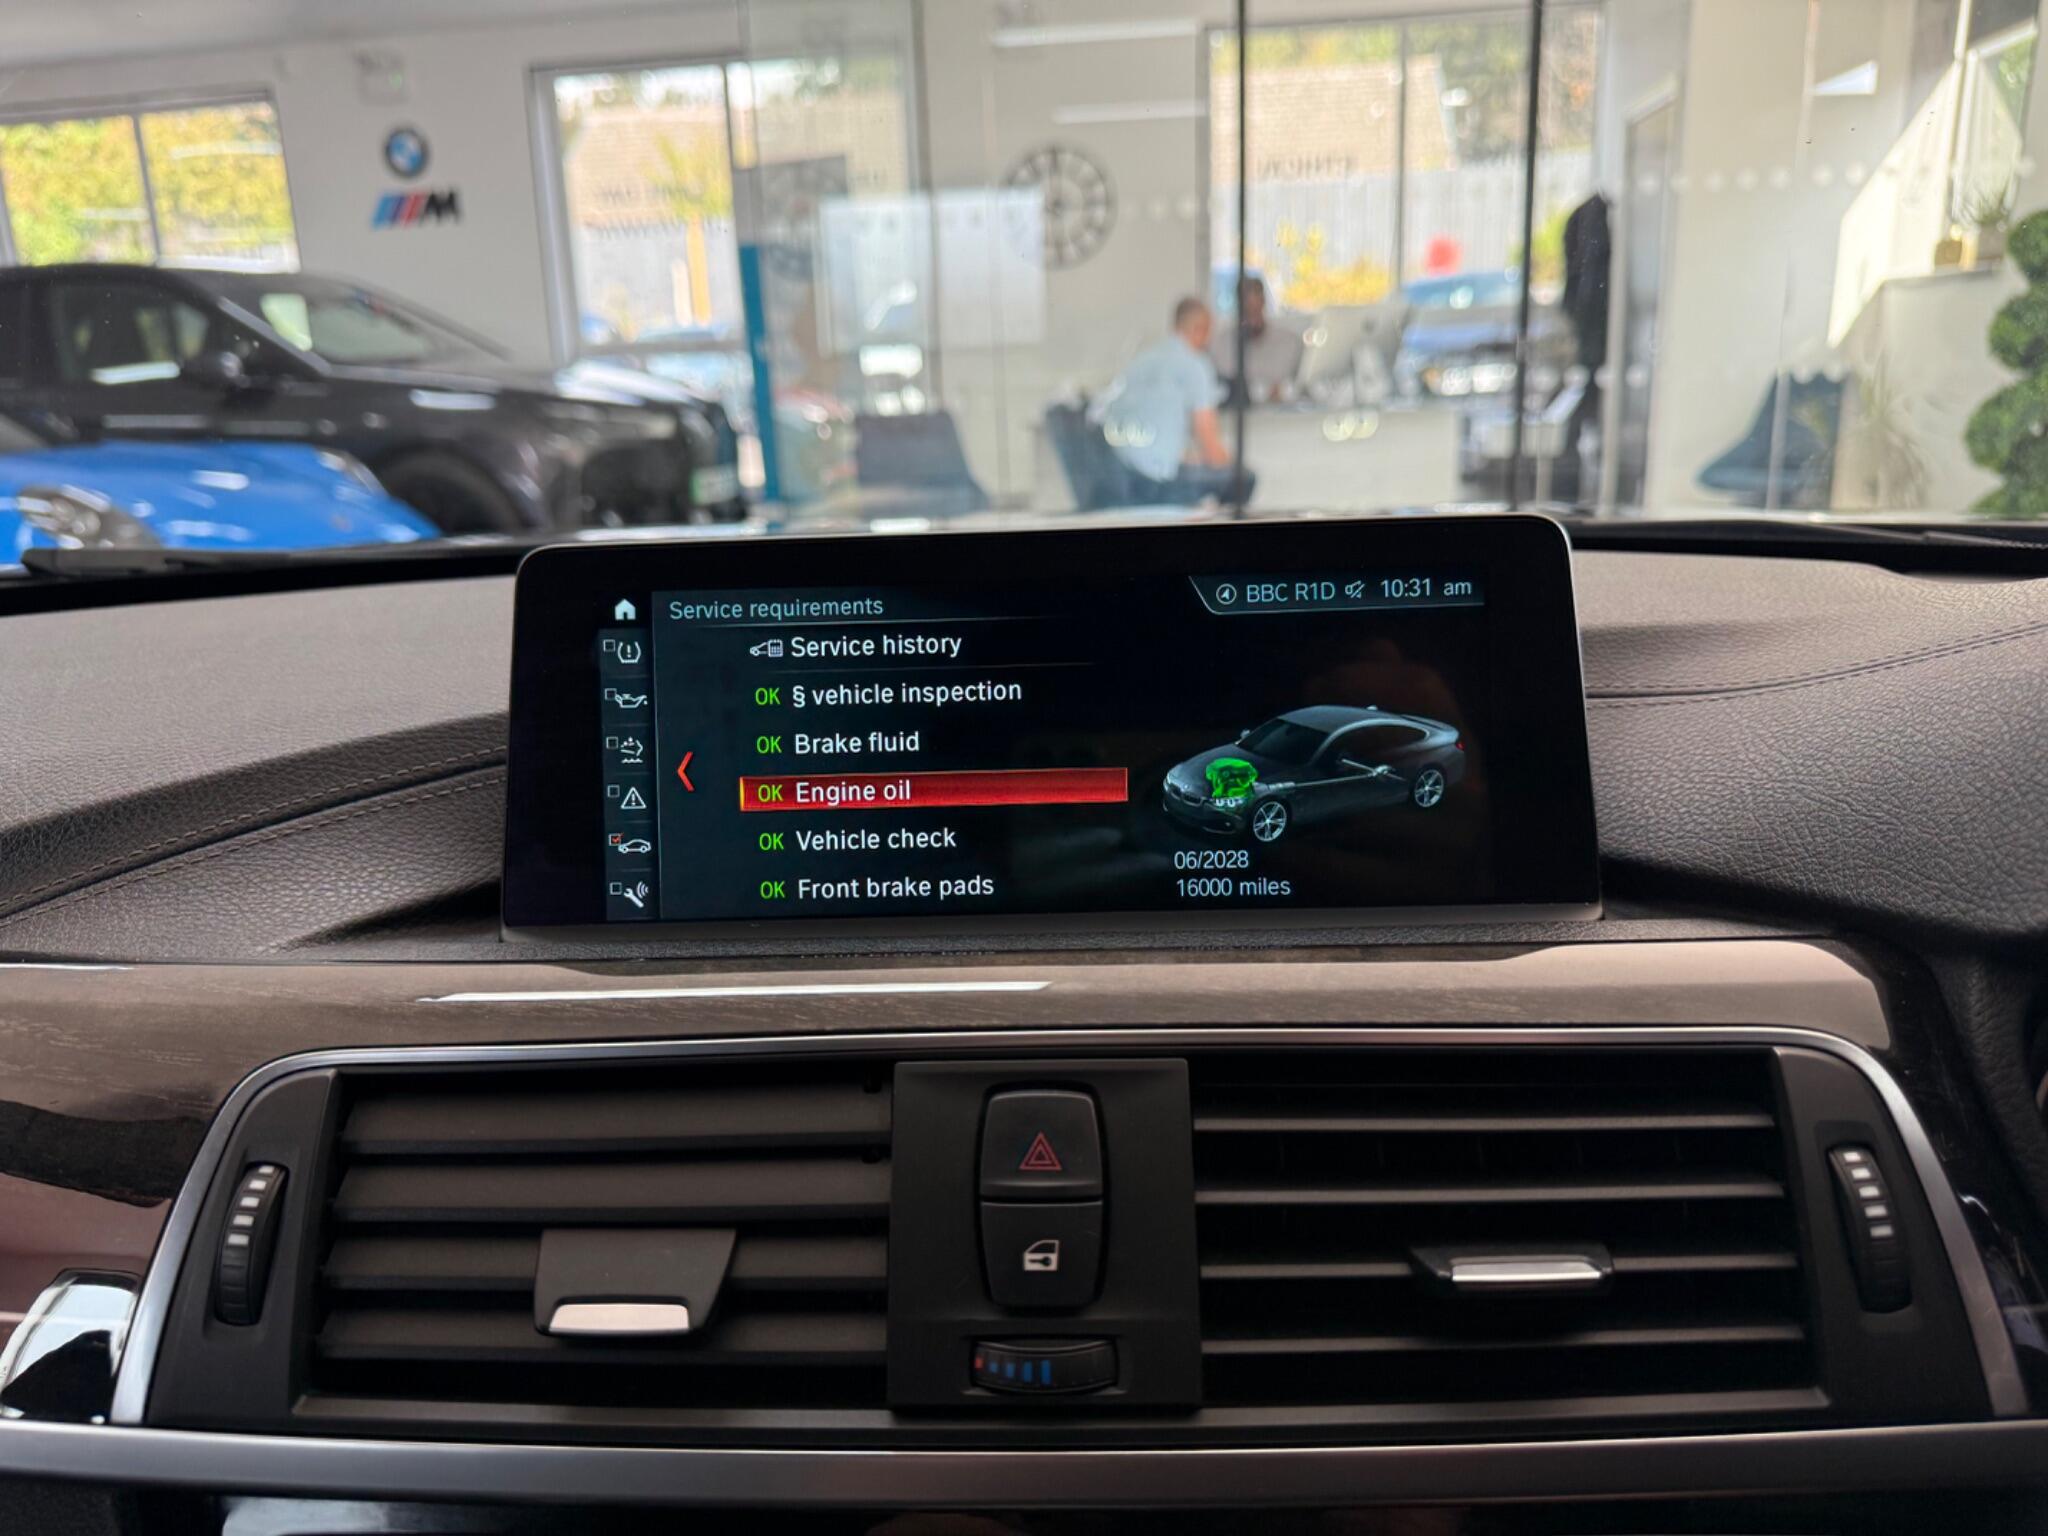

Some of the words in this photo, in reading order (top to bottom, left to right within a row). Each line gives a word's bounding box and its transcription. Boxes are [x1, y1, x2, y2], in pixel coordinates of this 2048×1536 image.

[1246, 584, 1288, 603] BBC
[1295, 582, 1336, 601] R1D
[1381, 579, 1432, 598] 10:31
[1443, 581, 1472, 596] am
[668, 600, 744, 620] Service
[749, 597, 885, 619] requirements
[790, 636, 876, 658] Service
[881, 633, 963, 657] history
[754, 688, 781, 707] OK
[812, 684, 893, 705] vehicle
[901, 680, 1022, 705] inspection
[756, 736, 783, 755] OK
[795, 734, 862, 754] Brake
[868, 732, 920, 753] fluid
[758, 785, 784, 803] OK
[796, 782, 876, 806] Engine
[883, 780, 912, 801] oil
[759, 833, 785, 851] OK
[796, 830, 880, 851] Vehicle
[887, 828, 957, 849] check
[1174, 850, 1250, 870] 06/2028
[760, 882, 786, 900] OK
[798, 879, 860, 899] Front
[867, 876, 932, 898] brake
[938, 875, 995, 899] pads
[1176, 878, 1233, 897] 16000
[1239, 876, 1292, 896] miles
